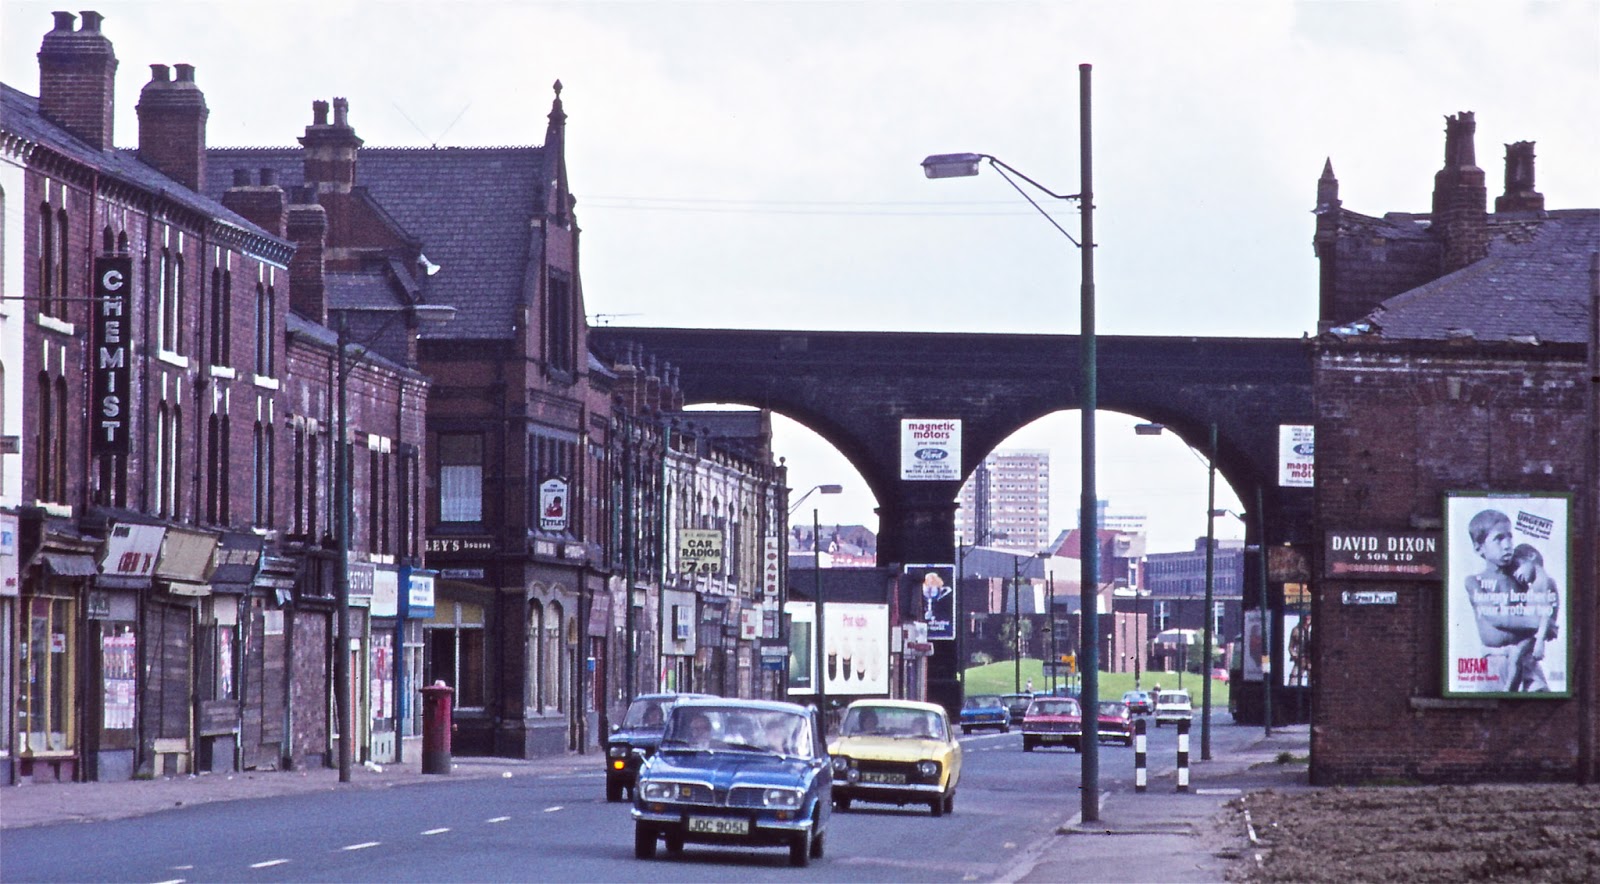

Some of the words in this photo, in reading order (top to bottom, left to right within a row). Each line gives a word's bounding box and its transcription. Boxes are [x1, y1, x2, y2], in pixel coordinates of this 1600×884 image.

[100, 269, 124, 441] CHEMIST
[908, 421, 955, 431] magnetic
[914, 431, 950, 439] motors
[920, 449, 943, 460] Ford
[541, 518, 565, 527] TETLEY
[1517, 513, 1552, 530] URGENT!
[464, 540, 491, 549] houses
[688, 540, 713, 548] CAR
[1332, 536, 1379, 551] DAVID
[1387, 537, 1436, 552] DIXON
[682, 548, 720, 557] RADIOS
[1353, 552, 1360, 560] &
[1394, 553, 1413, 561] LTD
[767, 541, 778, 592] LOANS
[1458, 658, 1488, 674] OXFAM
[691, 816, 714, 831] JDC
[716, 817, 748, 834] 905L
